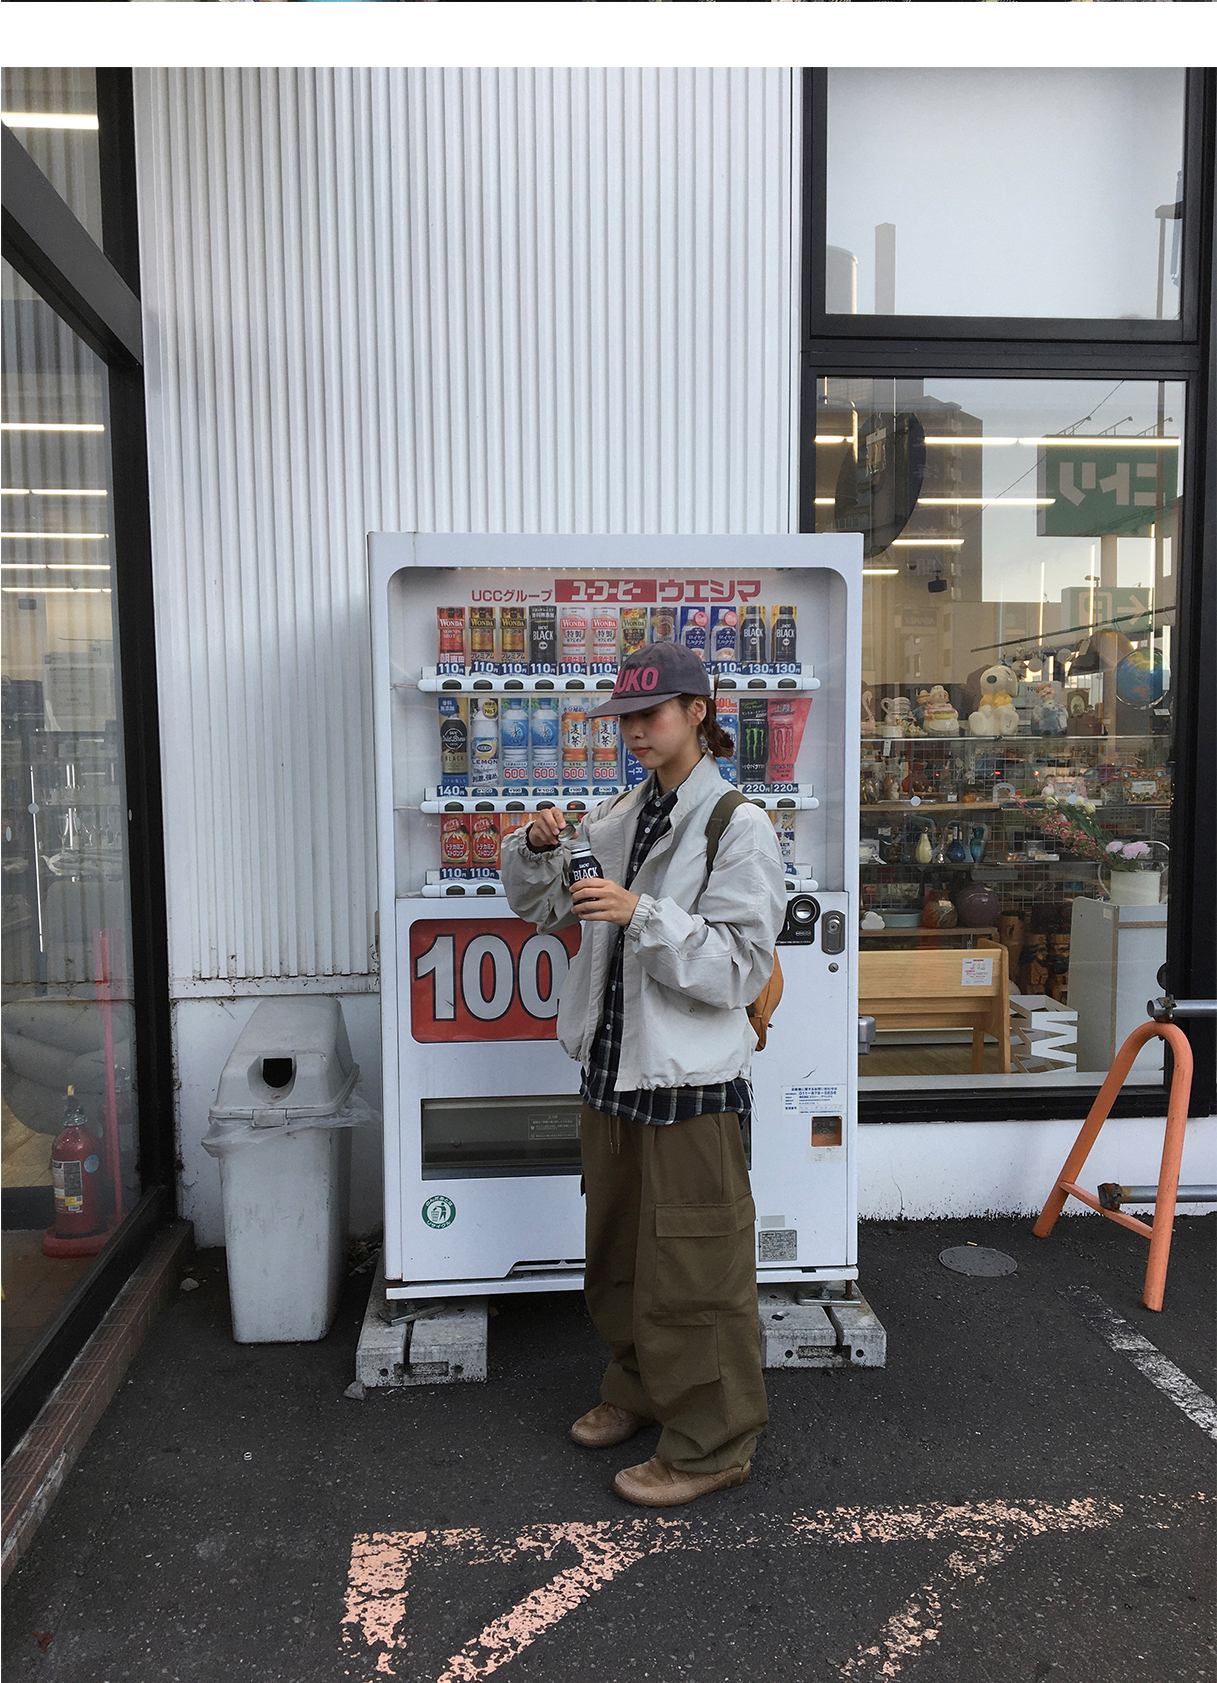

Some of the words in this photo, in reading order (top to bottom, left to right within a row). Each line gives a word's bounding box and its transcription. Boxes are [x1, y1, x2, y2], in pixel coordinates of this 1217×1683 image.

[472, 589, 553, 602] UCCグループ
[659, 579, 761, 602] ウエシマ
[439, 619, 463, 627] WONDA
[470, 619, 494, 627] WONDA
[502, 619, 525, 627] WONDA
[562, 619, 586, 628] WONDA
[532, 630, 554, 640] BLACK
[744, 628, 763, 637] BLACK
[777, 629, 795, 638] BLACK
[439, 663, 464, 673] 110円
[473, 662, 498, 673] 110円
[502, 663, 527, 673] 110円
[530, 663, 555, 673] 110円
[749, 663, 774, 673] 130円
[775, 663, 801, 673] 130円
[570, 723, 581, 746] 麦茶
[600, 723, 611, 746] 麦茶
[504, 768, 526, 778] 600
[534, 768, 556, 778] 600
[564, 768, 585, 778] 600
[438, 786, 465, 796] 140円
